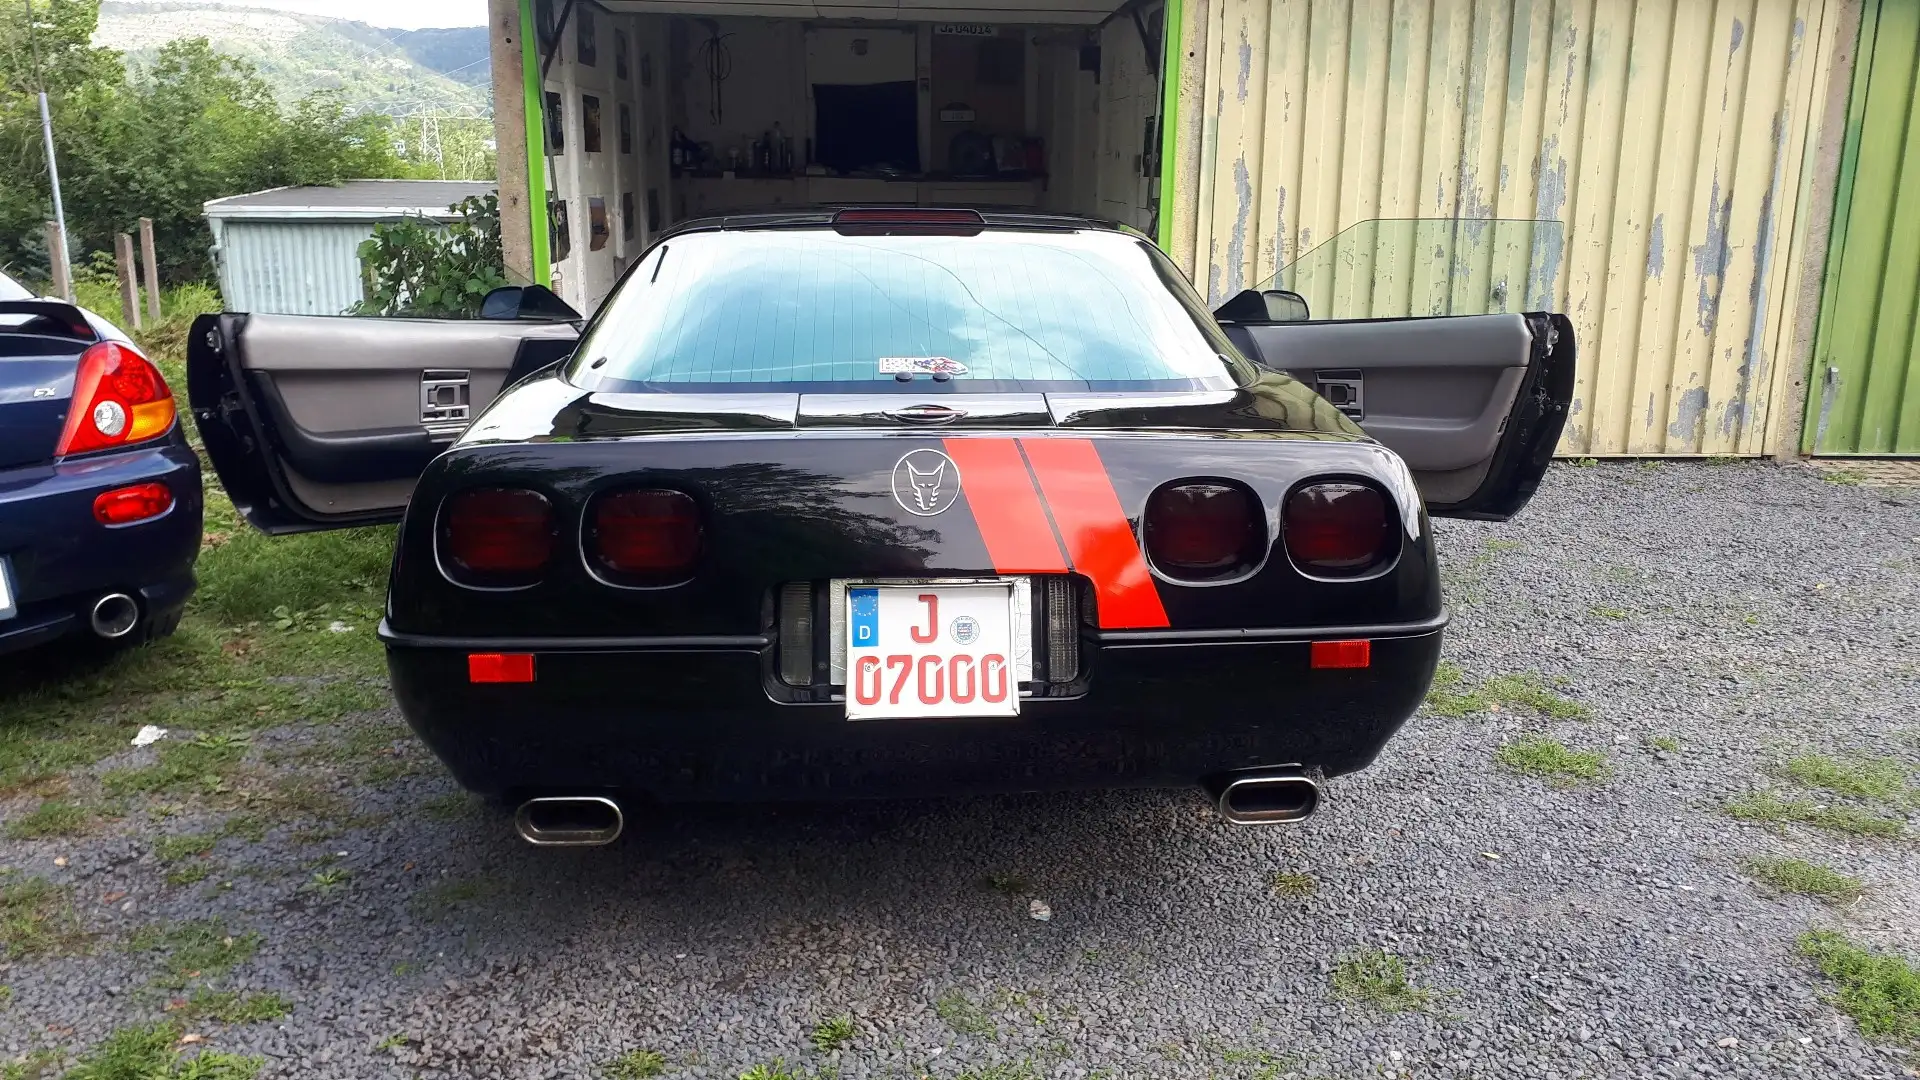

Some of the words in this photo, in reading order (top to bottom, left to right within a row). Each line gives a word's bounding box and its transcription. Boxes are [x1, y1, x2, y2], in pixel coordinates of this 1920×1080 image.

[33, 387, 56, 398] FX
[859, 625, 871, 640] D
[911, 594, 938, 643] J
[855, 653, 1007, 705] 07000
